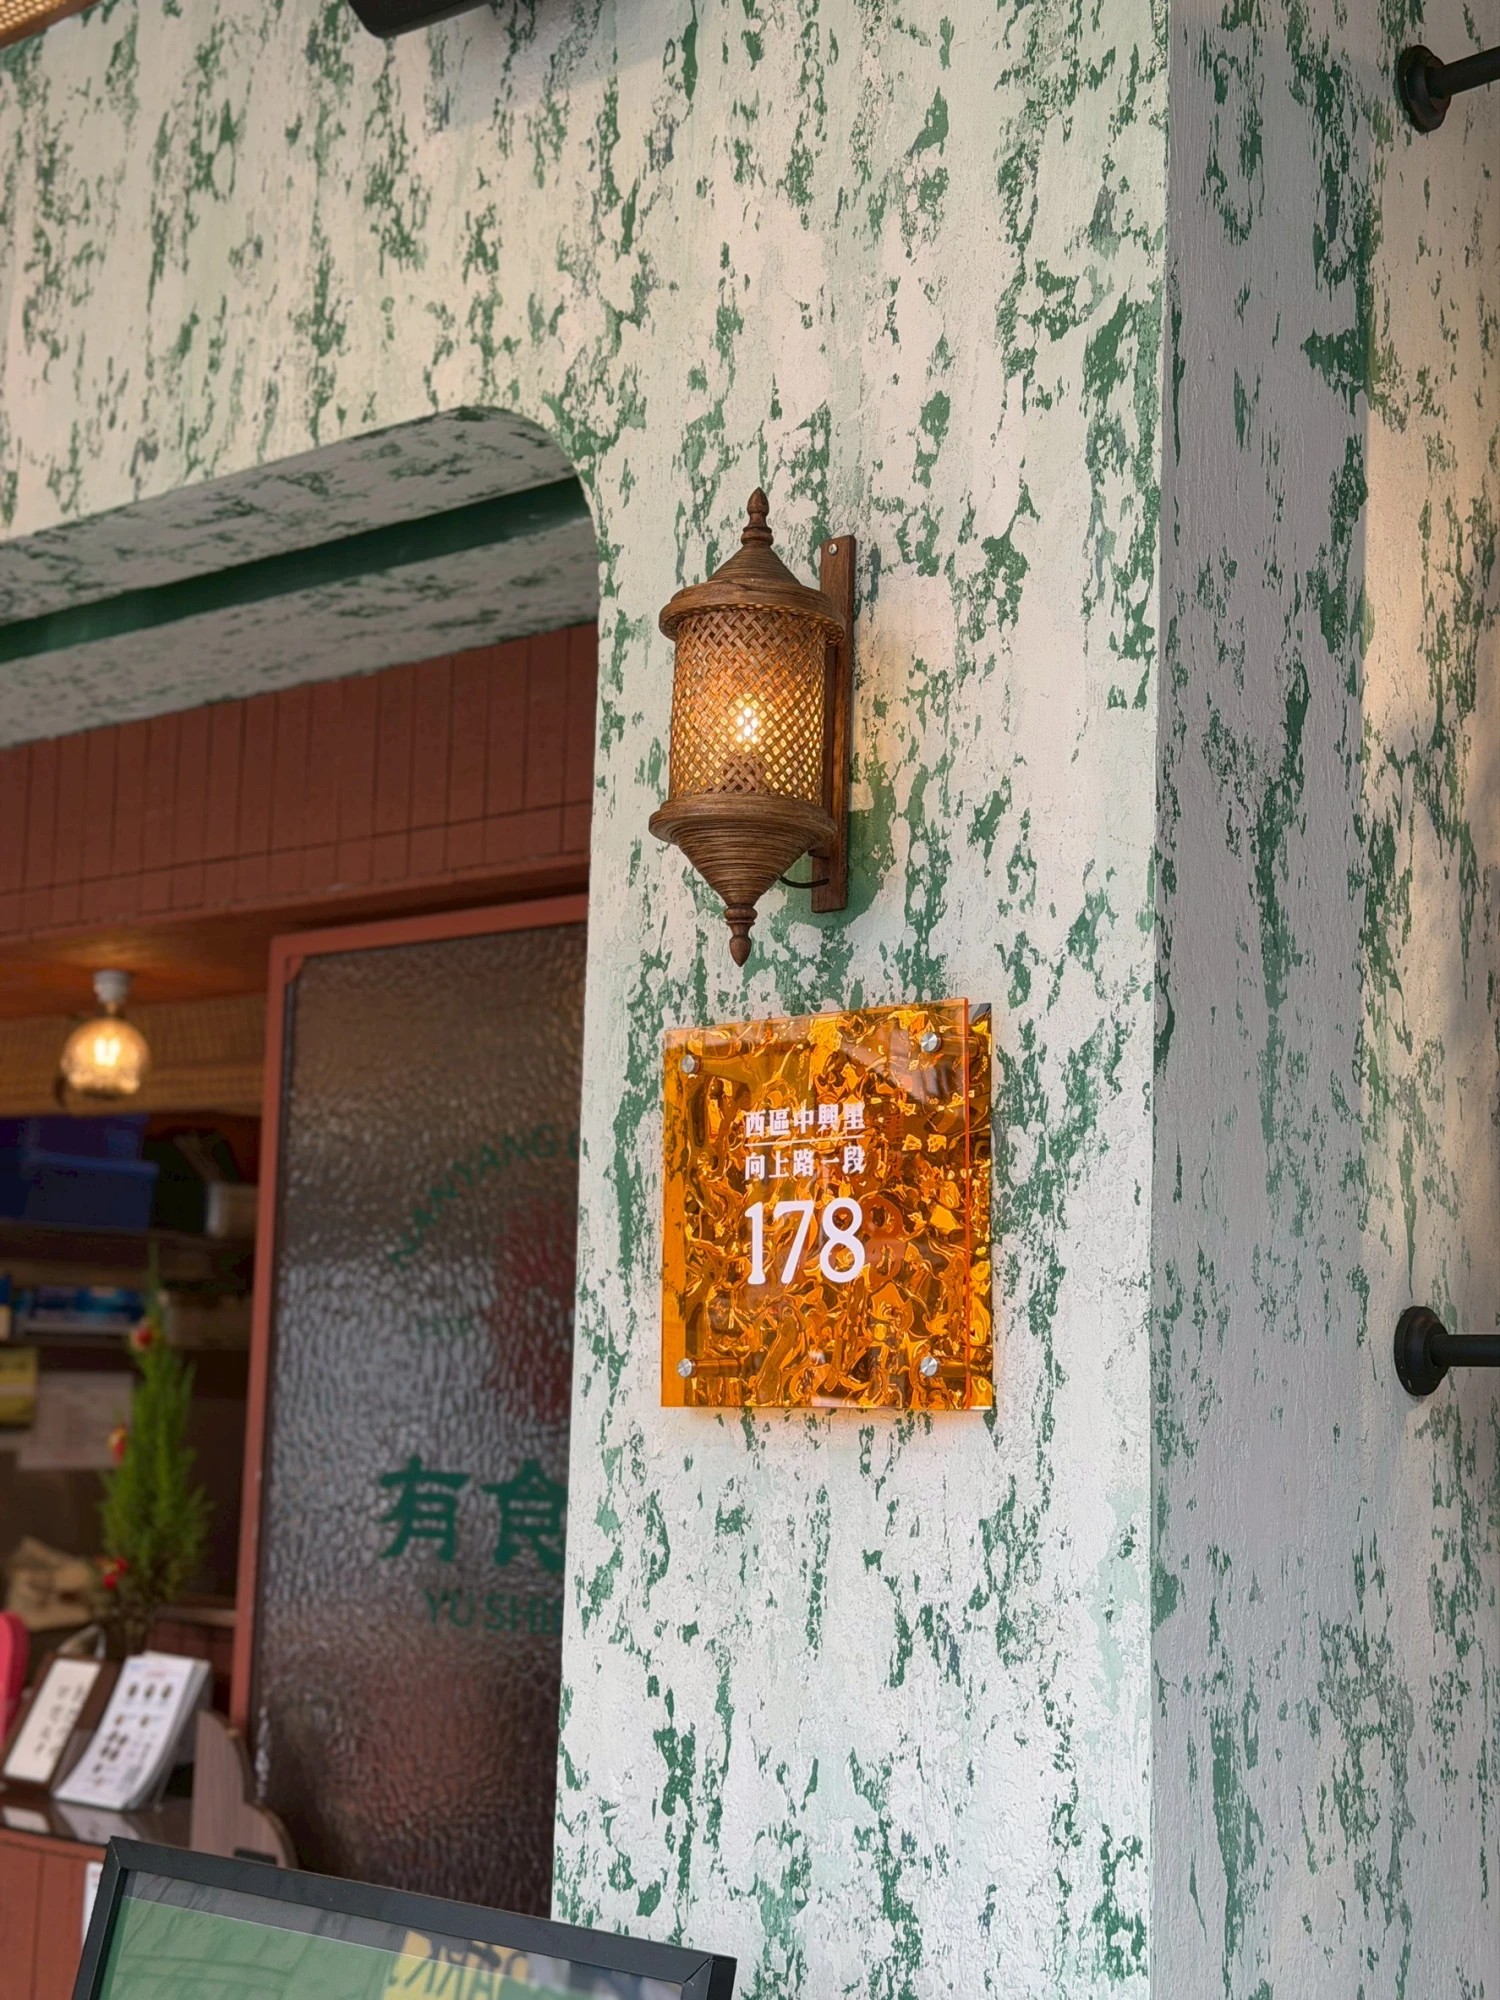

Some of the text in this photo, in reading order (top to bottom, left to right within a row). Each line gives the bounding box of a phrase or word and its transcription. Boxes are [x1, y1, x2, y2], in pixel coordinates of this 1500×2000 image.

[745, 1100, 866, 1138] 西區中興里
[744, 1144, 867, 1180] 向上路一段
[745, 1197, 866, 1285] 178
[377, 1455, 569, 1573] 有食
[421, 1588, 475, 1628] YU
